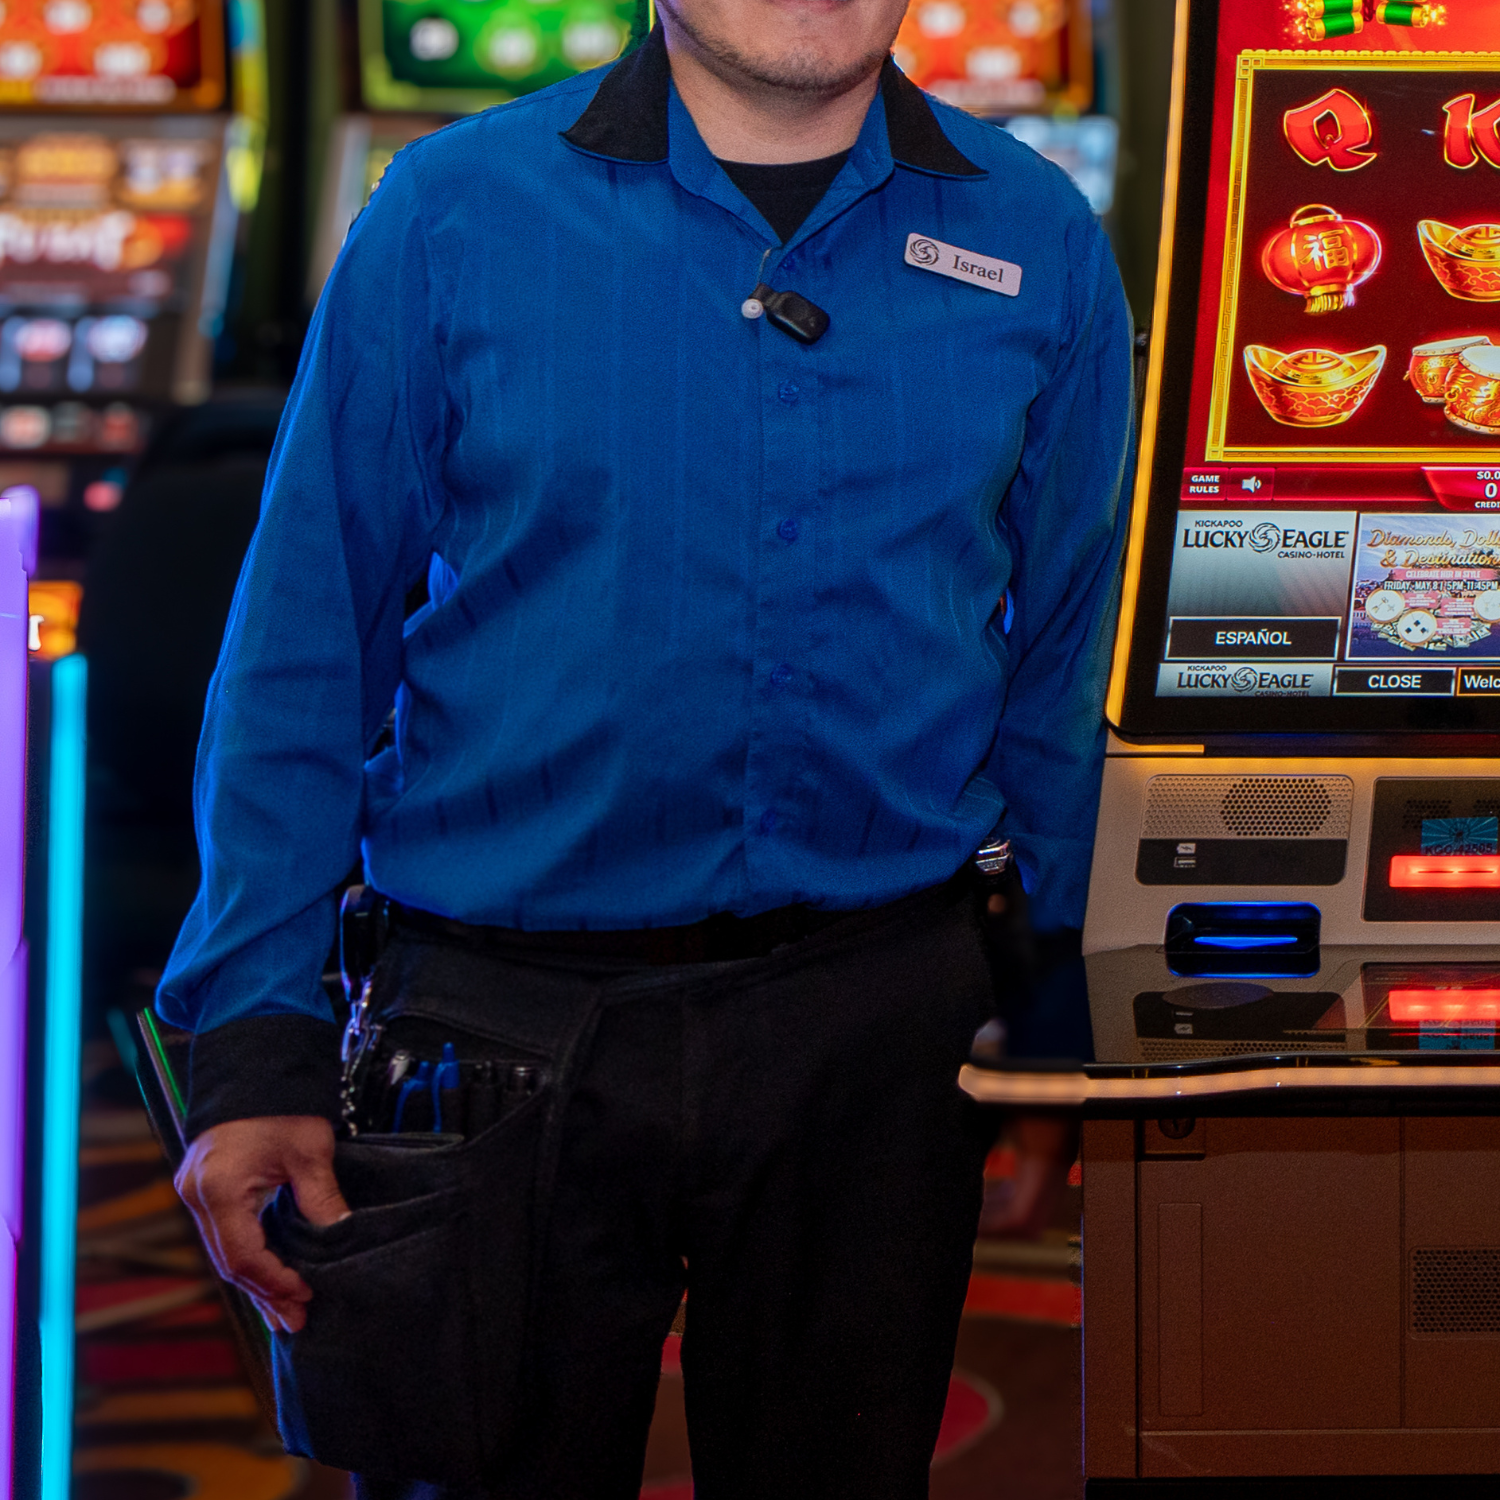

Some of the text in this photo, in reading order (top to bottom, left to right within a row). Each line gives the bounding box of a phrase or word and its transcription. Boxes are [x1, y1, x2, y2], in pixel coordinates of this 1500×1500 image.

[1283, 88, 1377, 173] Q
[1299, 233, 1351, 272] 福
[952, 254, 1004, 283] Israel
[1190, 475, 1220, 483] GAME
[1189, 485, 1220, 494] RULES
[1484, 483, 1498, 499] 0
[1195, 520, 1243, 528] KICKAPOO
[1182, 529, 1348, 548] LUCKY EAGLE
[1366, 529, 1457, 548] Diamonds,
[1380, 549, 1397, 568] &
[1215, 628, 1292, 646] ESPAÑOL
[1177, 672, 1314, 689] LUCKY EAGLE
[1368, 675, 1422, 688] CLOSE
